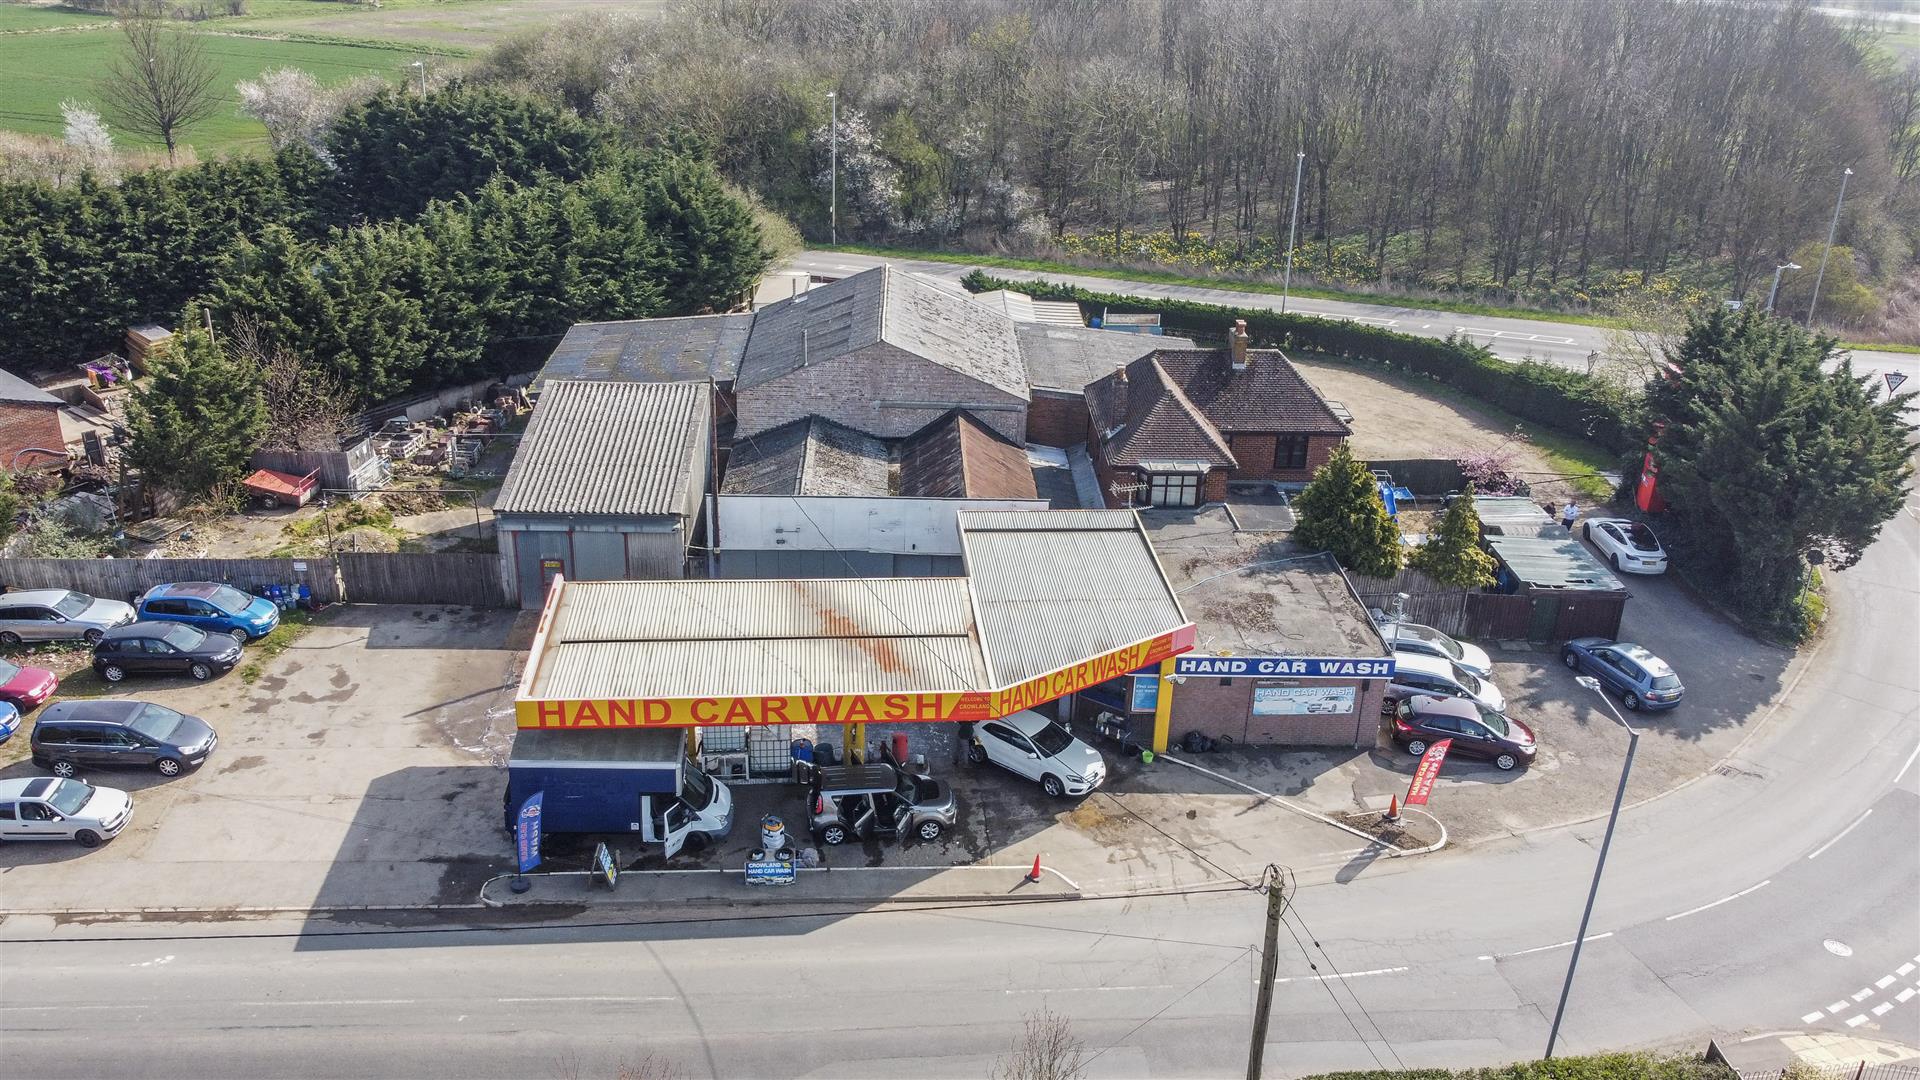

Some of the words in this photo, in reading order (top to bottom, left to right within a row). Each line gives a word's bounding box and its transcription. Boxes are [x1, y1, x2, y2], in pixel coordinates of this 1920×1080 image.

[1000, 676, 1048, 715] HAND
[1052, 661, 1088, 696] CAR
[1093, 645, 1139, 683] WASH
[1181, 660, 1247, 673] HAND
[1258, 660, 1307, 673] CAR
[1320, 662, 1389, 675] WASH
[1256, 689, 1290, 697] HAND
[1293, 689, 1317, 697] CAR
[1320, 687, 1353, 697] WASH
[537, 698, 672, 728] HAND
[690, 696, 791, 724] CAR
[801, 692, 943, 722] WASH
[1411, 777, 1423, 796] HAND
[1418, 762, 1430, 777] CAR
[1419, 762, 1439, 796] WASH
[530, 820, 539, 857] WASH
